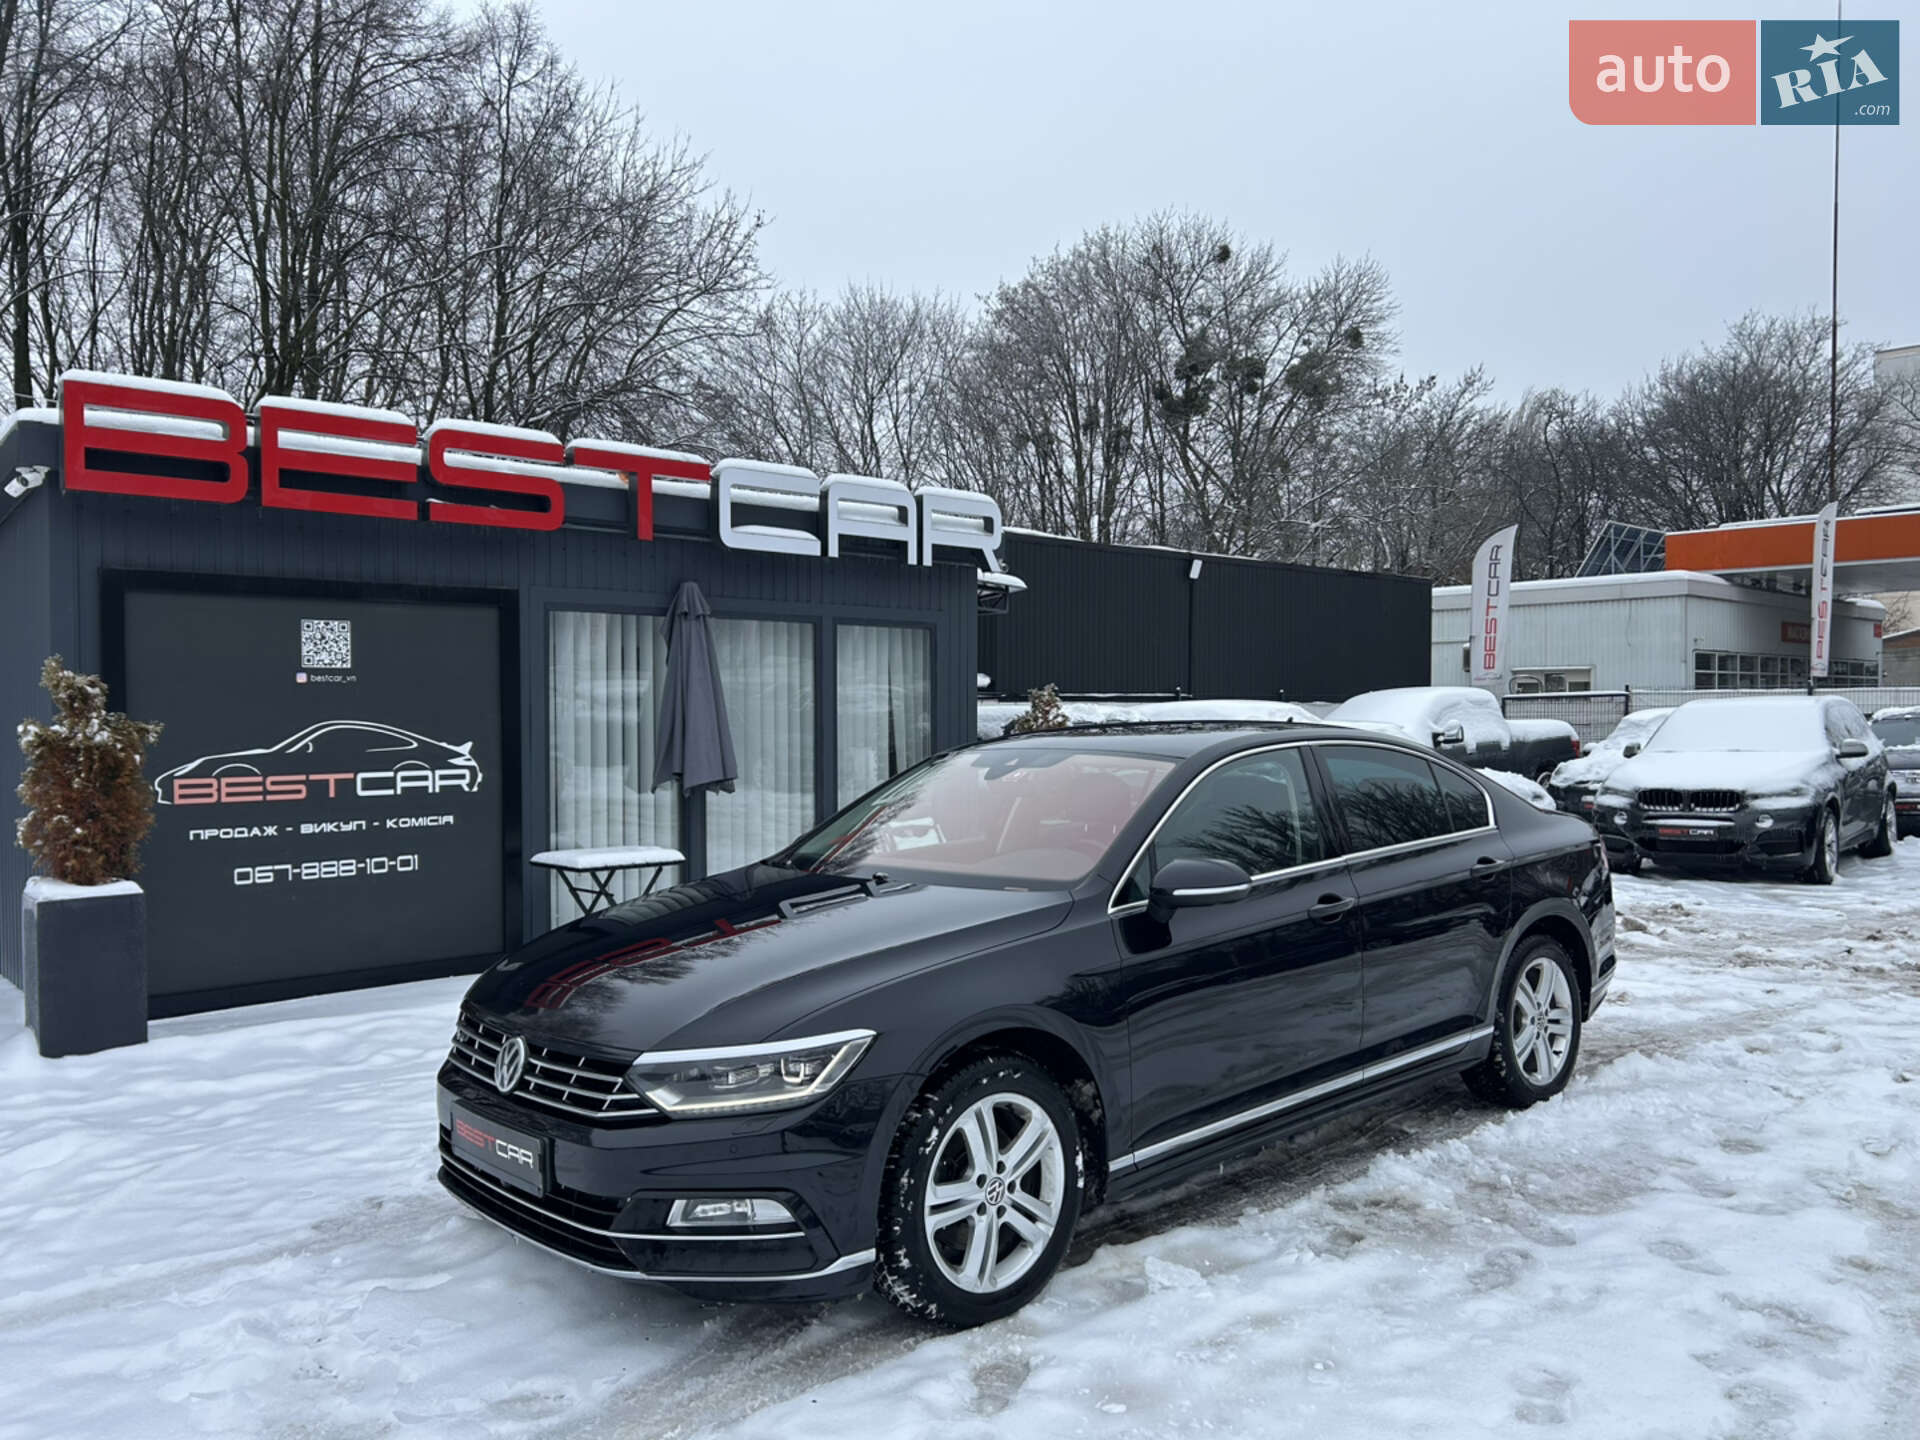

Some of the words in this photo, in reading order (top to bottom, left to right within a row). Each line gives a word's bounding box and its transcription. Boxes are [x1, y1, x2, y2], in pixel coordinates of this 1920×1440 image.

[189, 825, 279, 841] ПРОДАЖ
[300, 820, 366, 834] ВИКУП
[386, 815, 454, 829] КОМІСІЯ
[233, 854, 419, 885] 067-888-10-01
